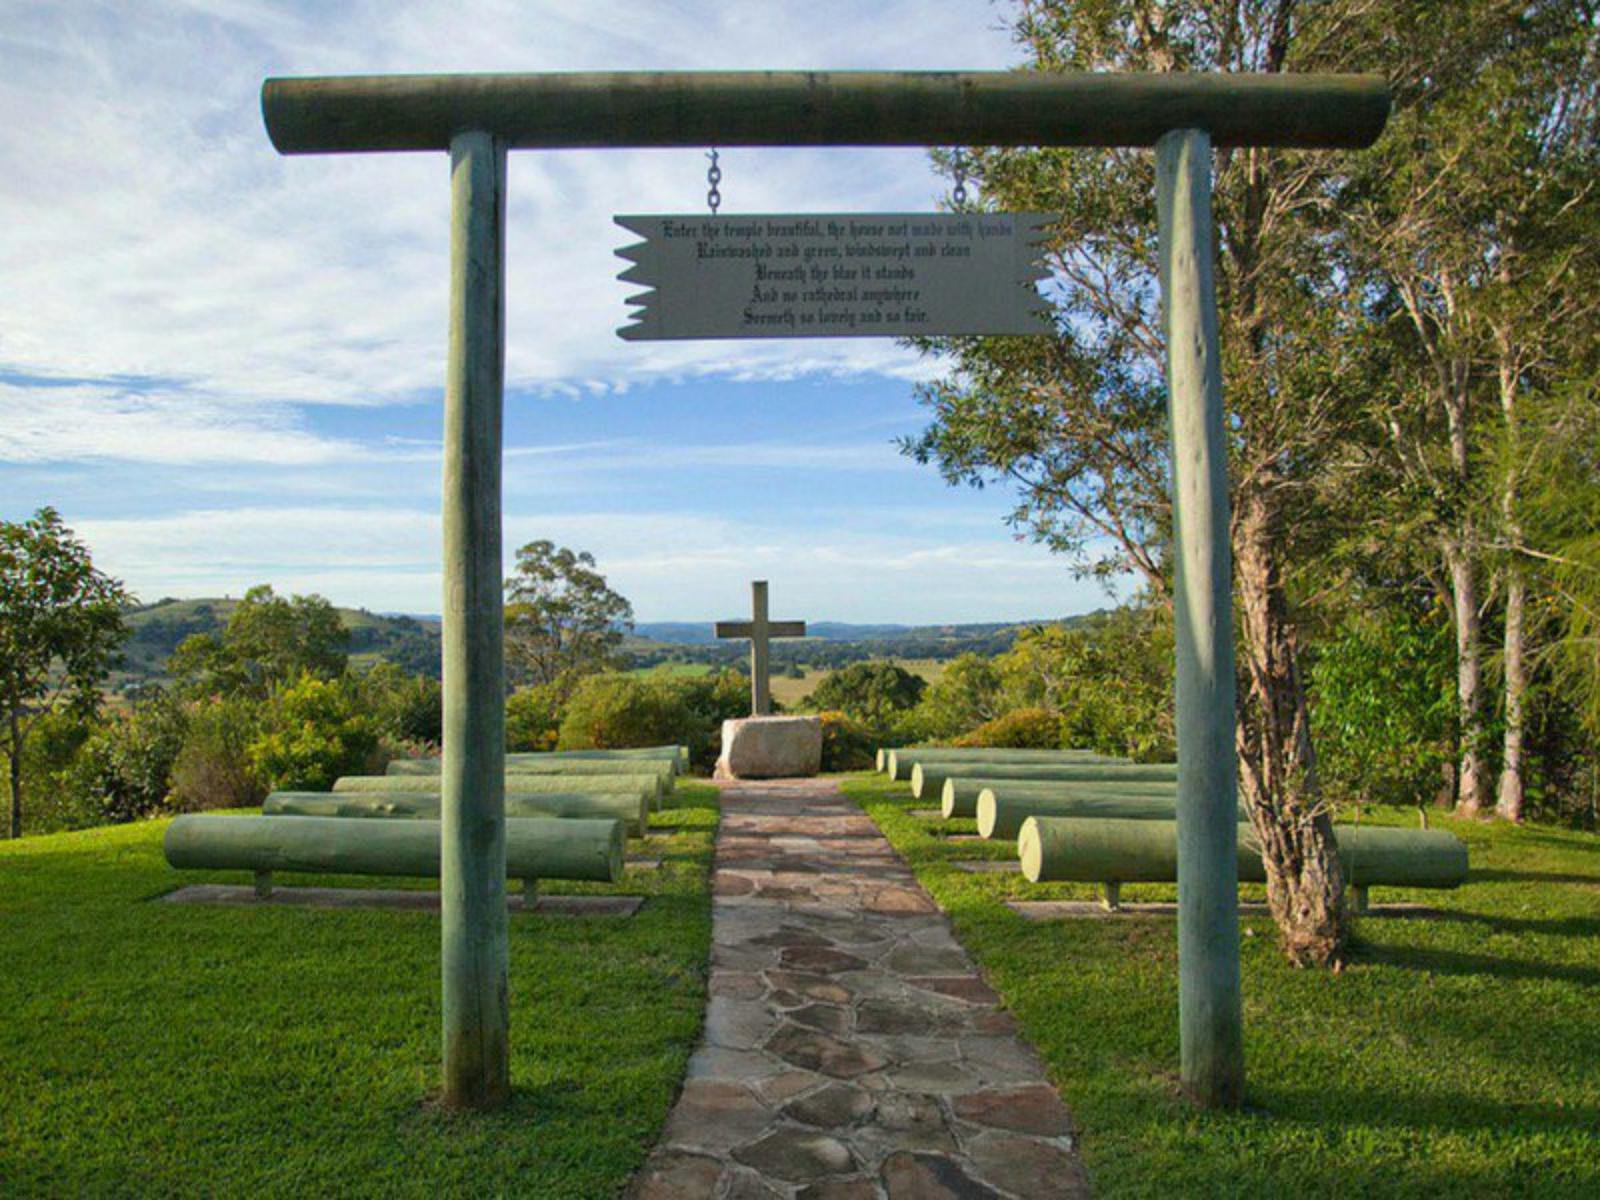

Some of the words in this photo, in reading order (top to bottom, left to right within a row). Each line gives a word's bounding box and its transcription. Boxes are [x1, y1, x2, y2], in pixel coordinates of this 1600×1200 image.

[661, 220, 697, 238] Enter
[702, 221, 720, 240] the
[724, 222, 763, 240] temple
[828, 221, 845, 239] the
[849, 220, 884, 239] house
[888, 222, 908, 237] not
[911, 223, 943, 237] made
[947, 222, 973, 239] with
[776, 243, 799, 258] and
[845, 242, 910, 260] windswept
[914, 243, 936, 257] and
[941, 243, 970, 257] clean
[755, 263, 806, 283] Beneath
[811, 265, 828, 283] the
[832, 265, 857, 280] blue
[862, 265, 871, 280] it
[875, 265, 915, 280] stands
[751, 285, 778, 304] And
[783, 292, 798, 302] no
[802, 287, 857, 305] cathedral
[862, 286, 920, 305] anywhere
[743, 308, 794, 327] Seemeth
[799, 313, 814, 324] so
[819, 308, 856, 327] lovely
[860, 309, 882, 323] and
[886, 311, 900, 323] so
